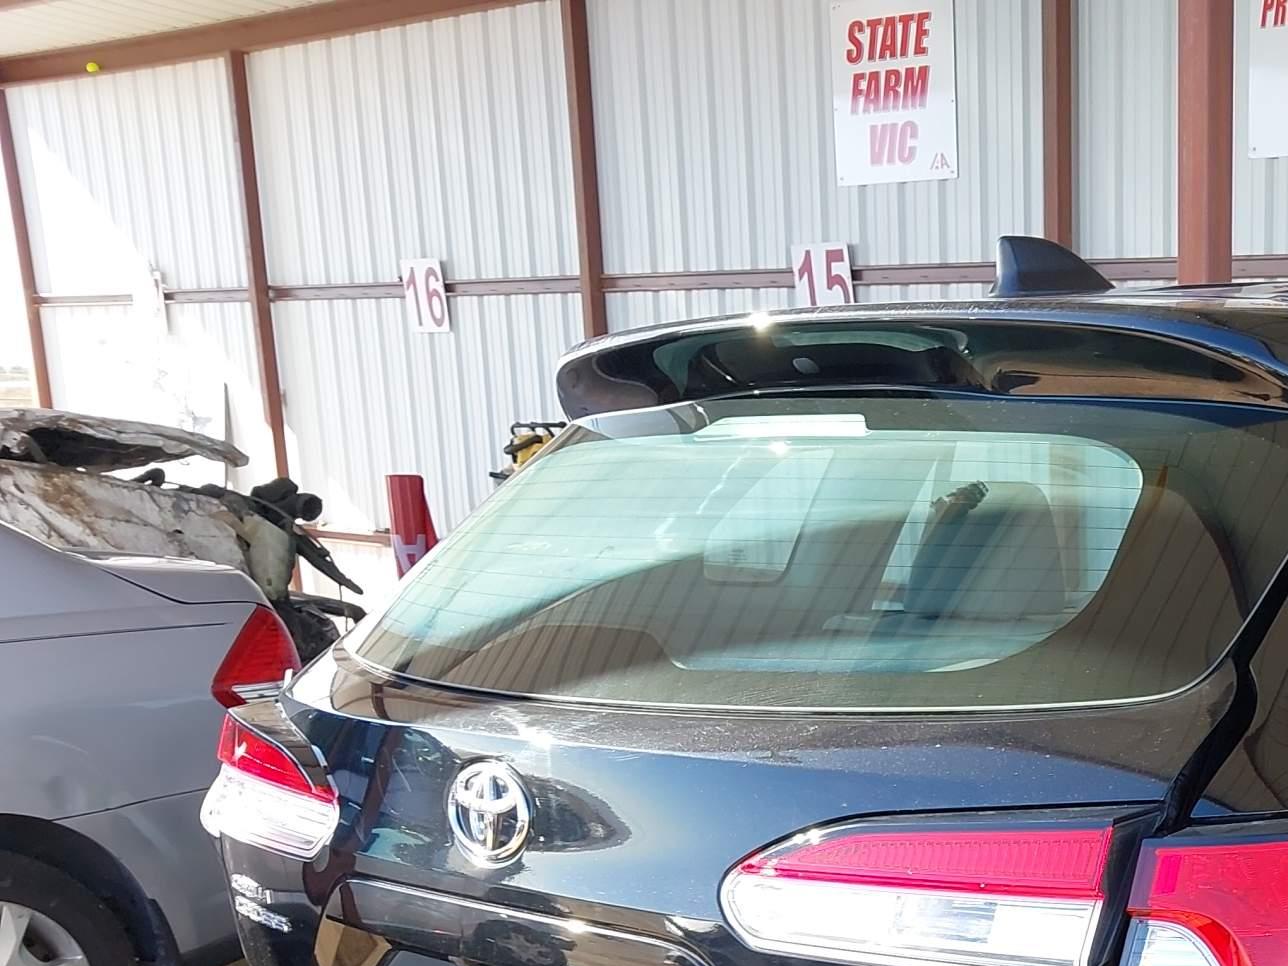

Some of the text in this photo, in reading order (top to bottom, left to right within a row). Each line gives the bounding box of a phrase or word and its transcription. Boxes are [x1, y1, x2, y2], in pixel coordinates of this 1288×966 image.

[846, 11, 932, 65] STATE
[850, 65, 930, 115] FARM
[869, 119, 919, 168] VIC
[405, 266, 446, 328] 16
[798, 248, 851, 307] 15
